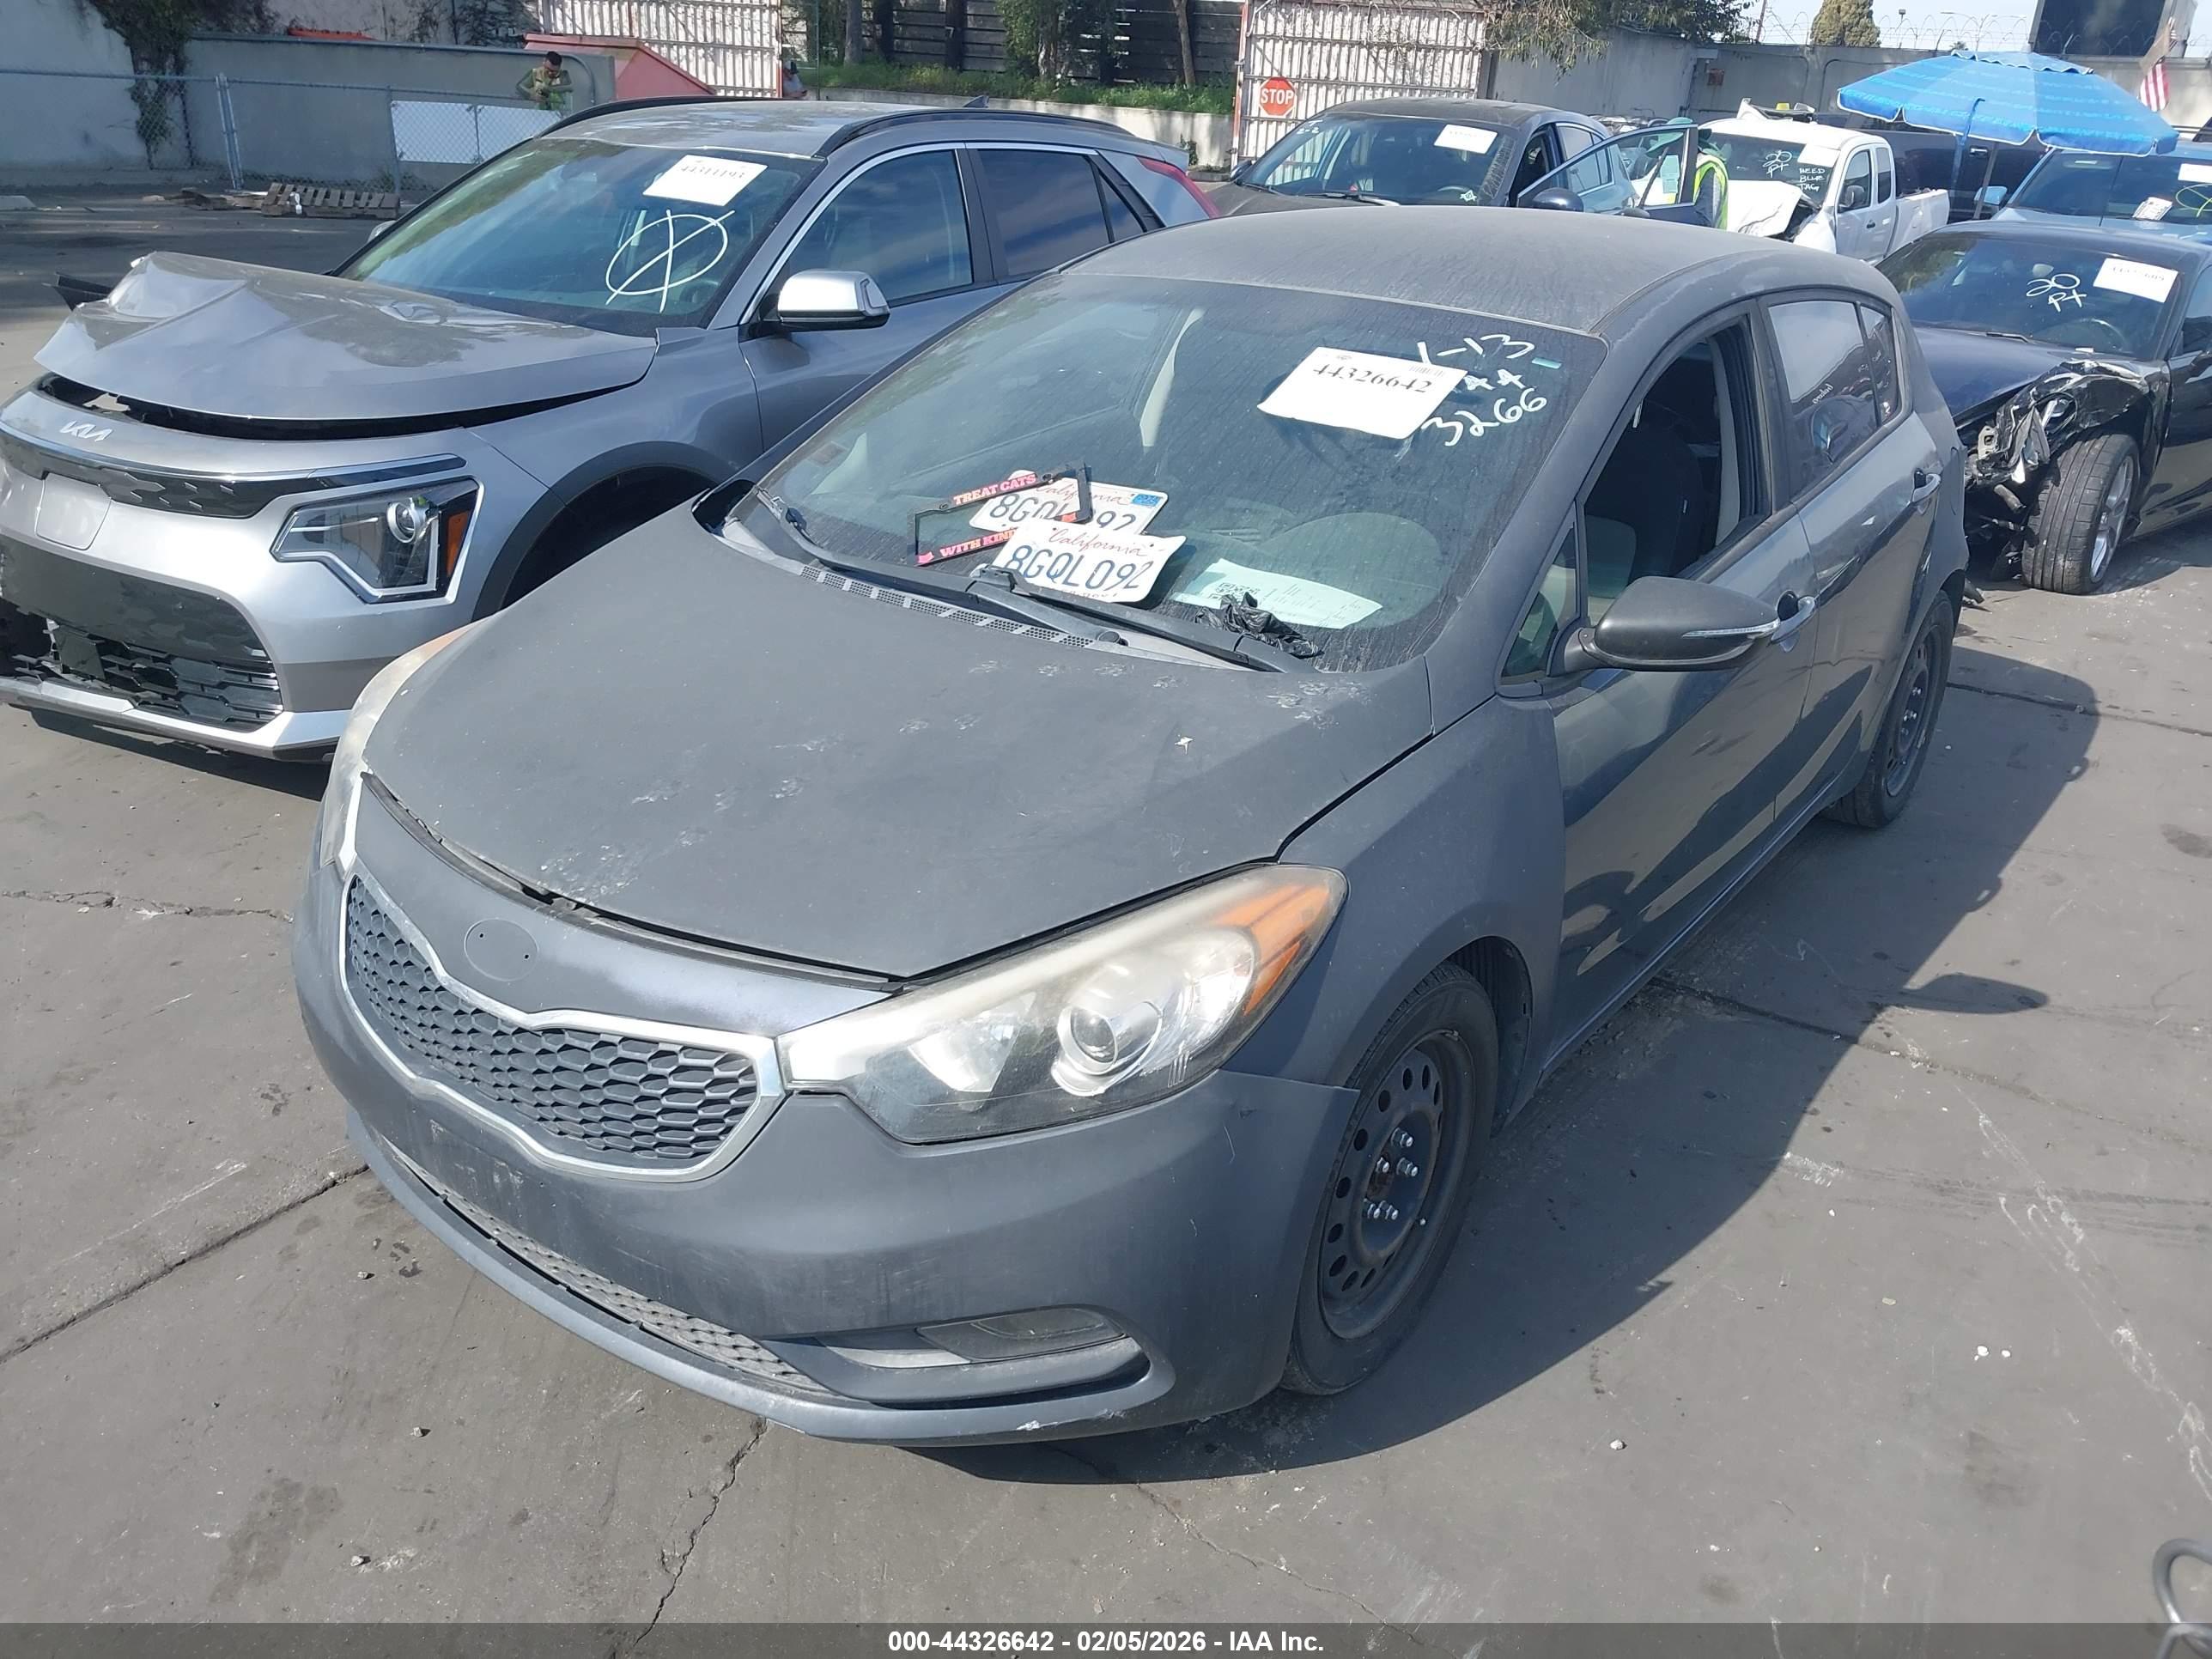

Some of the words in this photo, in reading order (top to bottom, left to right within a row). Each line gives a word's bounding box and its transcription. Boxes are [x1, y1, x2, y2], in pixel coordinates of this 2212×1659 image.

[1260, 88, 1294, 105] STOP
[2027, 274, 2081, 297] 20
[1312, 363, 1432, 393] 44326642
[58, 420, 114, 442] KIA
[953, 484, 999, 506] TREAT
[1000, 473, 1036, 491] CATS
[939, 538, 982, 558] WITH
[1048, 528, 1149, 557] California
[1004, 544, 1154, 592] 8GQL092
